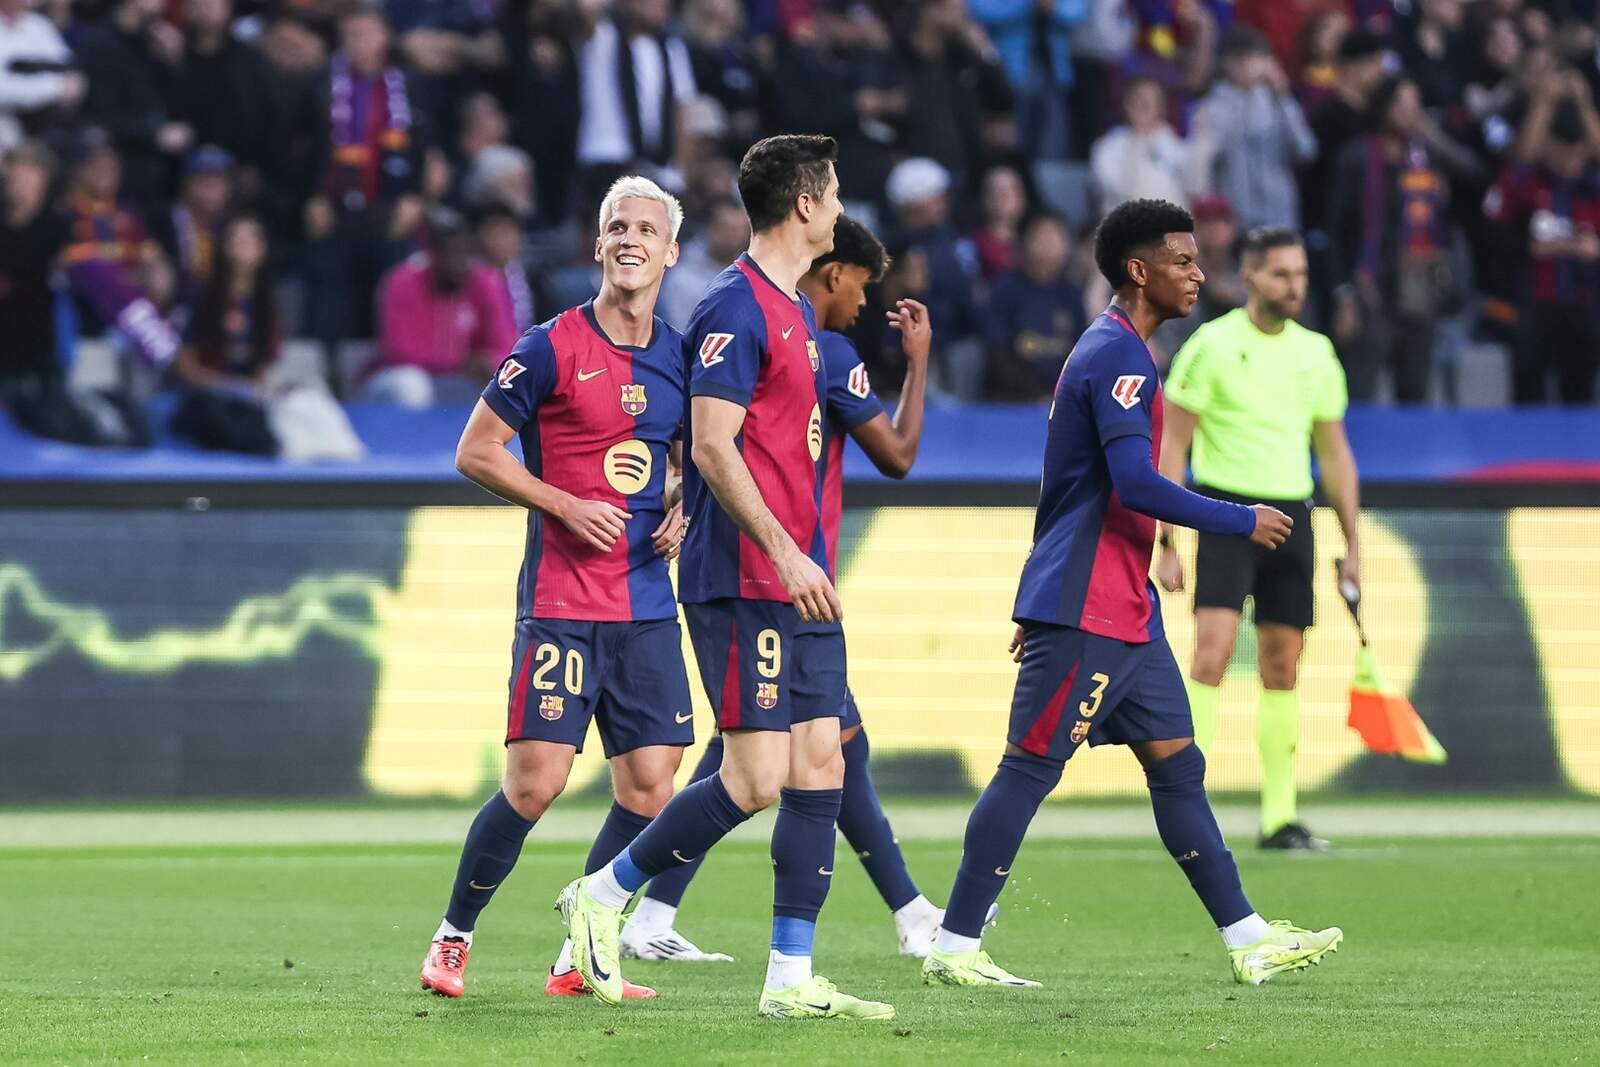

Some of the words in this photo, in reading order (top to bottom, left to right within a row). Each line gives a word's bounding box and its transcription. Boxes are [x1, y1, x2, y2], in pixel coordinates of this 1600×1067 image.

[533, 643, 583, 695] 20
[757, 628, 781, 678] 9
[1079, 672, 1109, 718] 3
